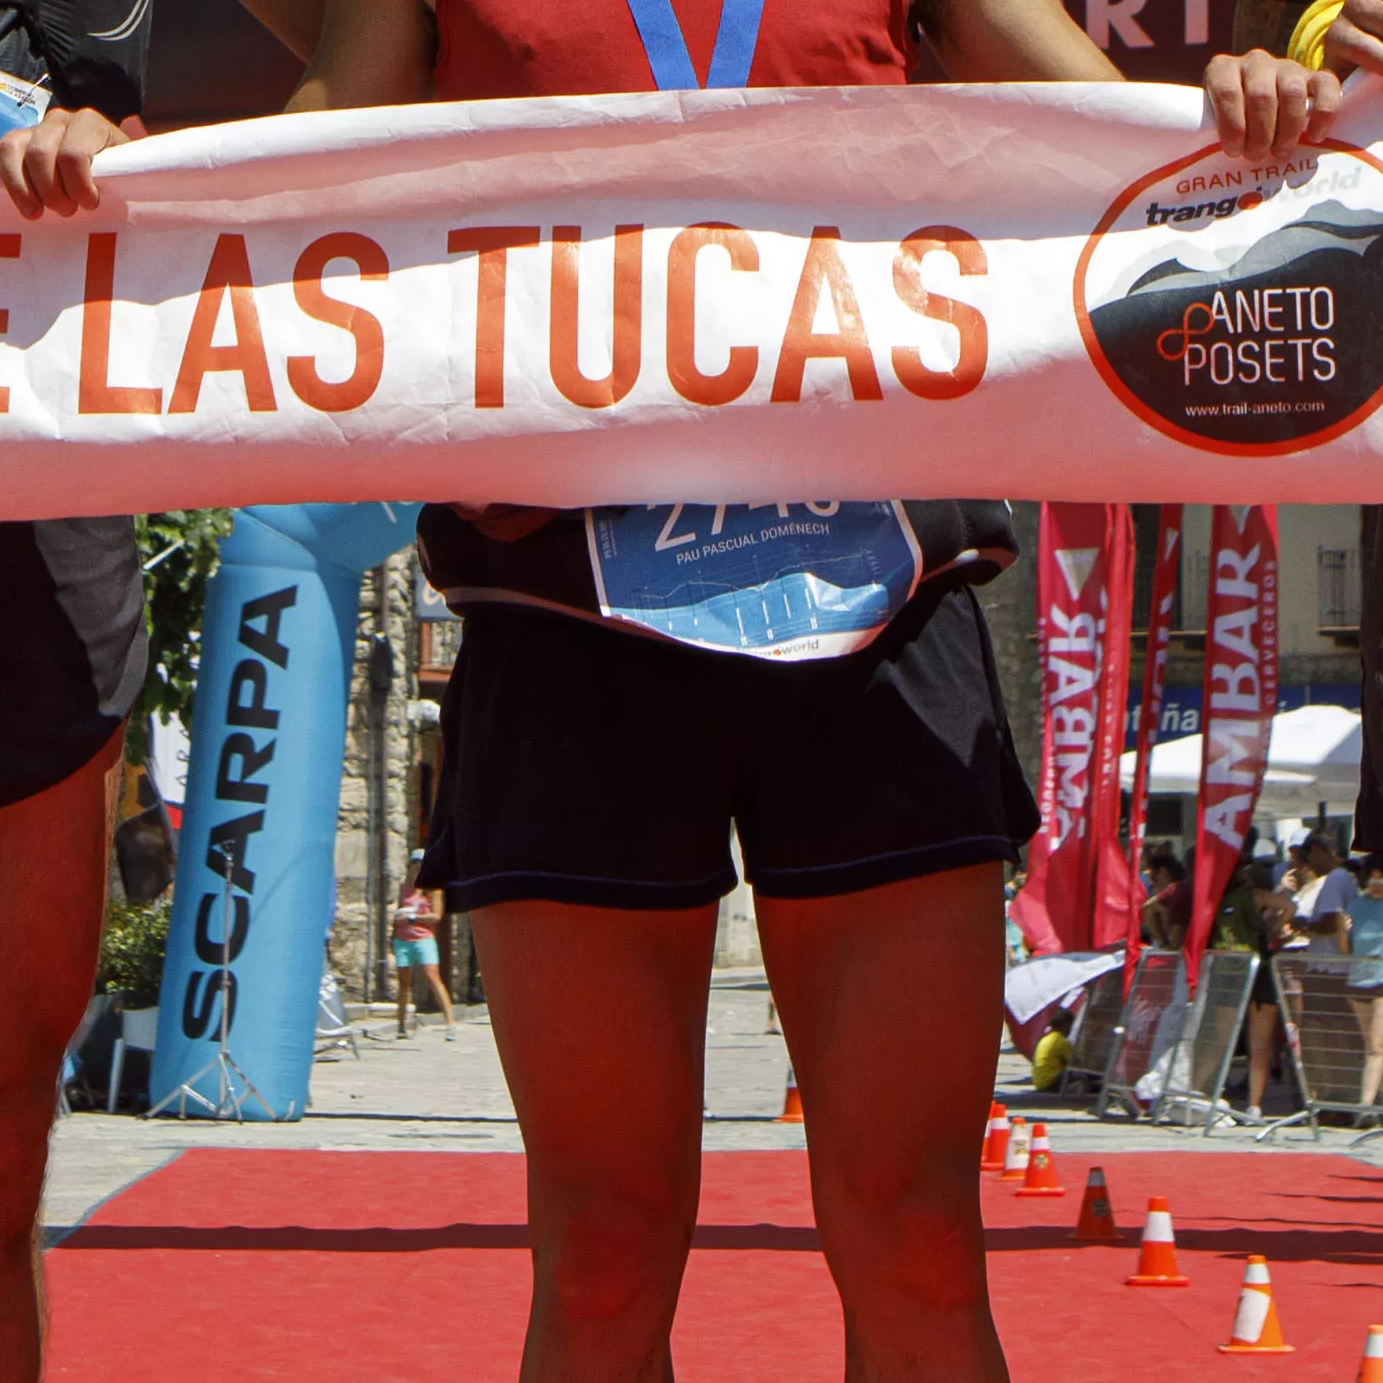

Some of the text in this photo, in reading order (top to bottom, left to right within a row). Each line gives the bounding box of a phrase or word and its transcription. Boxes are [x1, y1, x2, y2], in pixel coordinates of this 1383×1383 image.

[1175, 158, 1322, 196] GRAN TRAIL
[77, 230, 391, 415] LAS
[446, 221, 990, 409] TUCAS
[1211, 286, 1335, 335] ANETO
[1183, 337, 1337, 386] POSETS
[1185, 399, 1326, 418] www.trail-aneto.com
[675, 549, 701, 566] PAU
[702, 532, 759, 557] PASCUAL
[1203, 541, 1262, 851] AMBAR
[182, 583, 300, 1044] SCARPA
